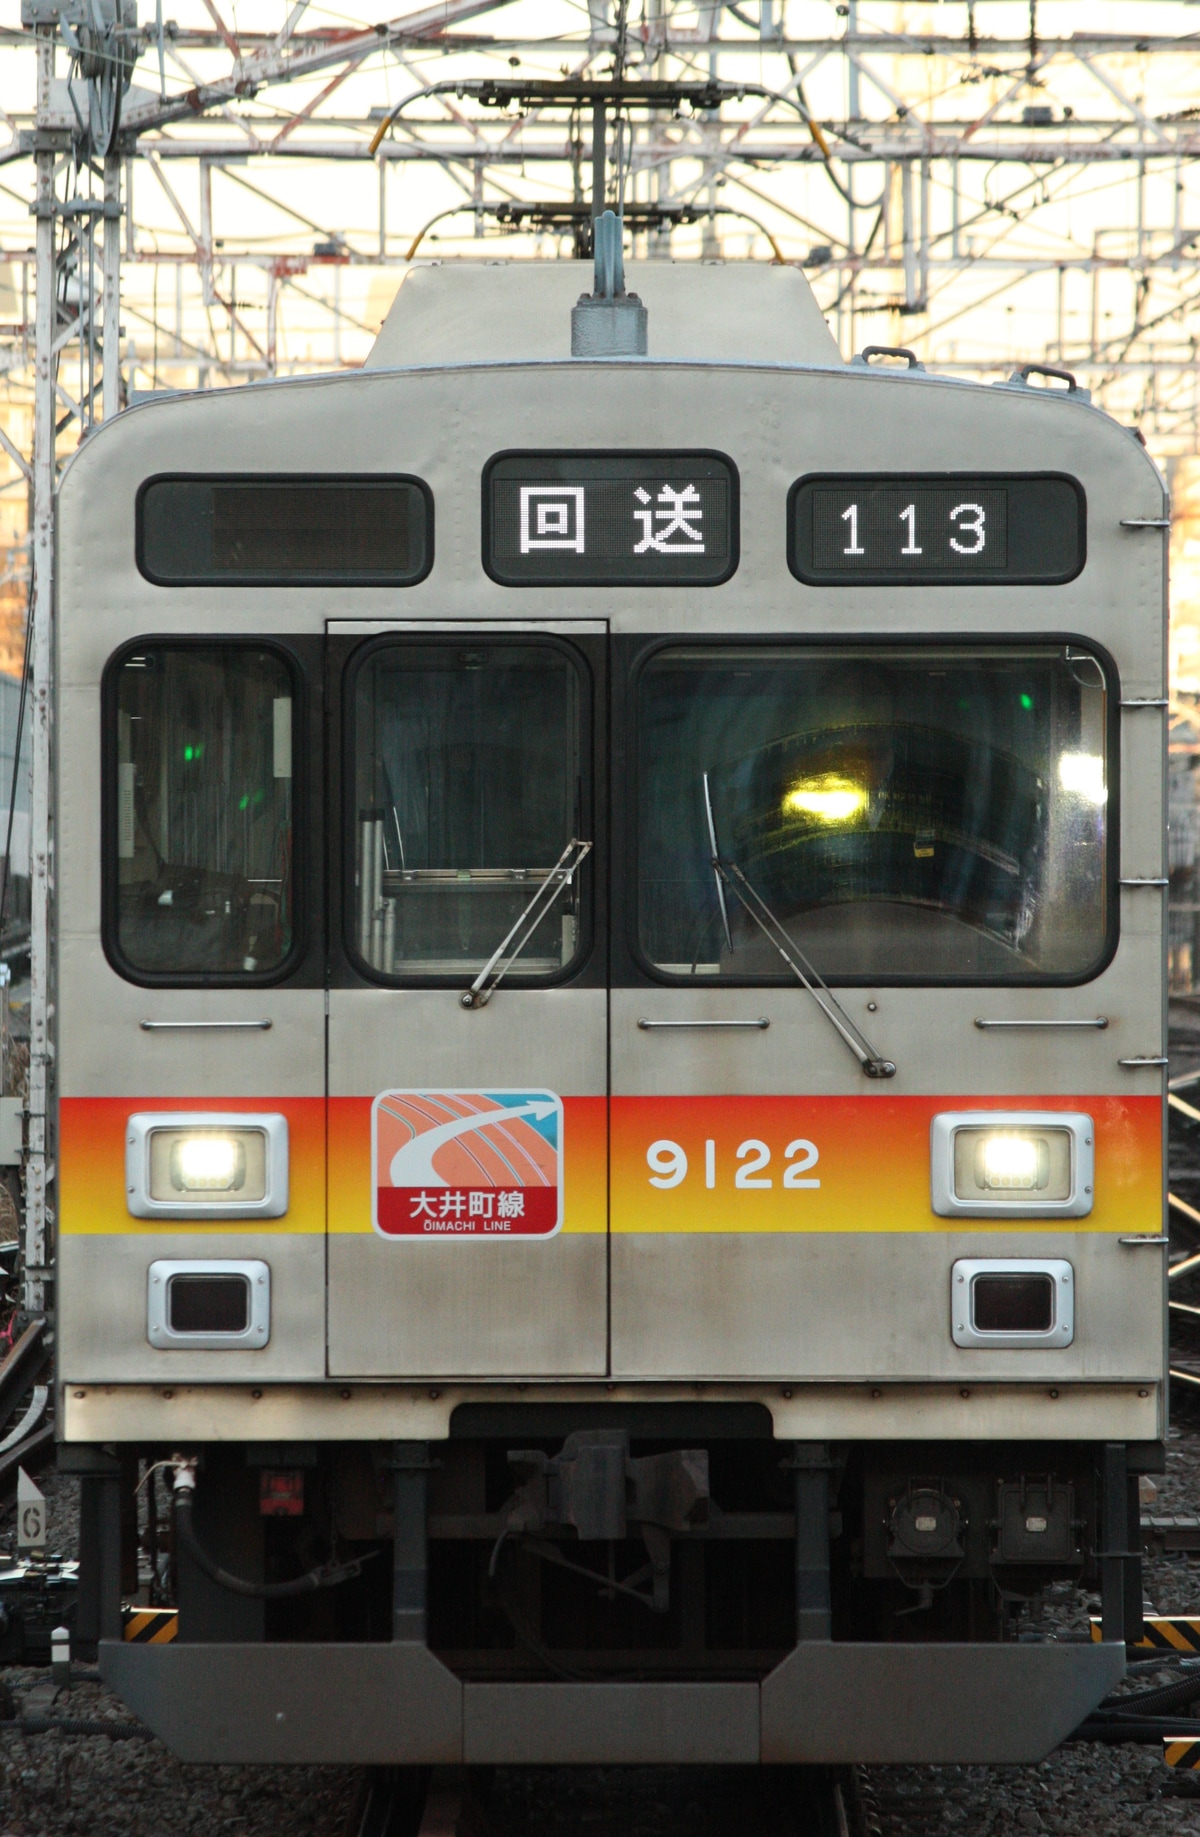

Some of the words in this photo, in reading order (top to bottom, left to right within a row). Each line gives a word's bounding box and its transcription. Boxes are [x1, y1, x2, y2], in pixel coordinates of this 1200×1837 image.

[520, 484, 705, 553] 回送
[841, 504, 985, 554] 113
[646, 1139, 821, 1189] 9122
[409, 1191, 525, 1218] 大井町線
[483, 1221, 511, 1231] LINE
[23, 1507, 41, 1538] 6
